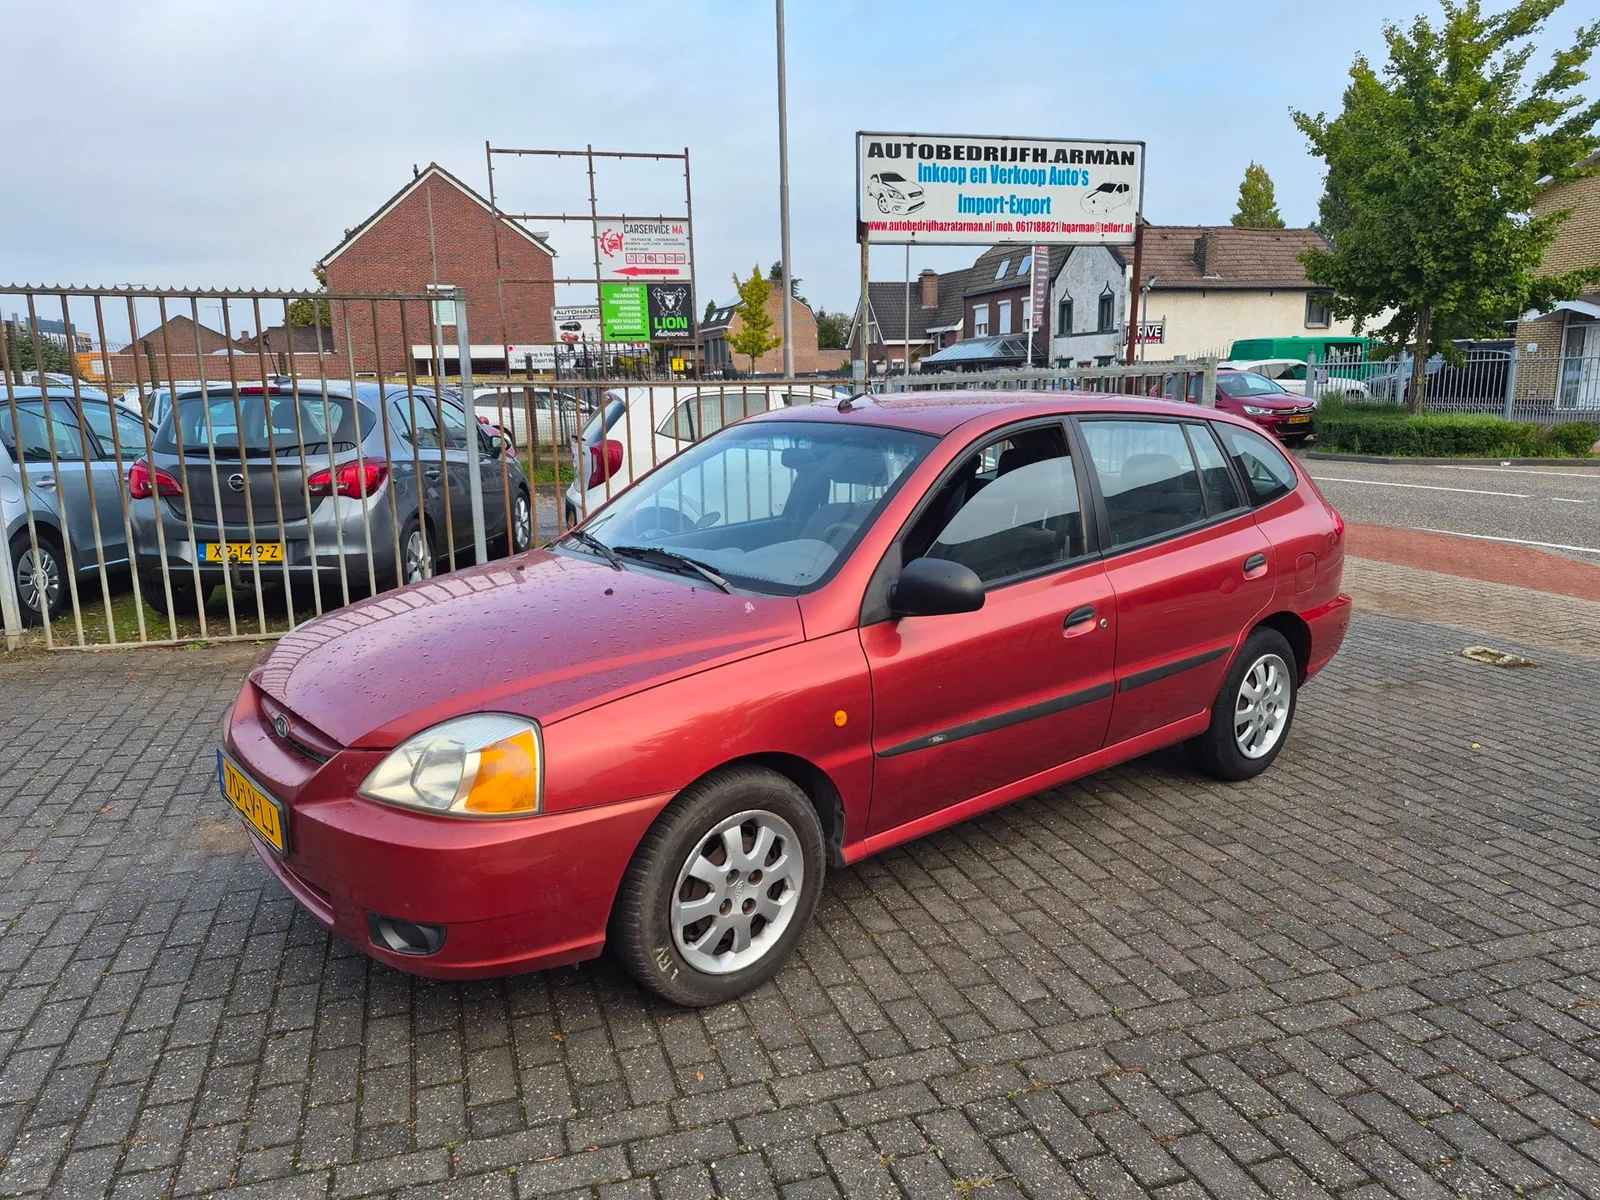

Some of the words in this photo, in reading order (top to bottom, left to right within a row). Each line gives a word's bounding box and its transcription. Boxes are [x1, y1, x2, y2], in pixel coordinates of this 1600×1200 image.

[917, 162, 967, 185] Inkoop
[969, 166, 987, 184] en
[990, 164, 1046, 187] Verkoop
[1049, 166, 1090, 187] Auto's
[957, 193, 1052, 216] Import-Export
[623, 224, 670, 235] CARSERVICE
[671, 225, 684, 235] MA
[996, 220, 1014, 233] mob.
[1016, 221, 1059, 233] 0617188821
[654, 317, 688, 329] LION
[655, 329, 689, 337] Autoservice
